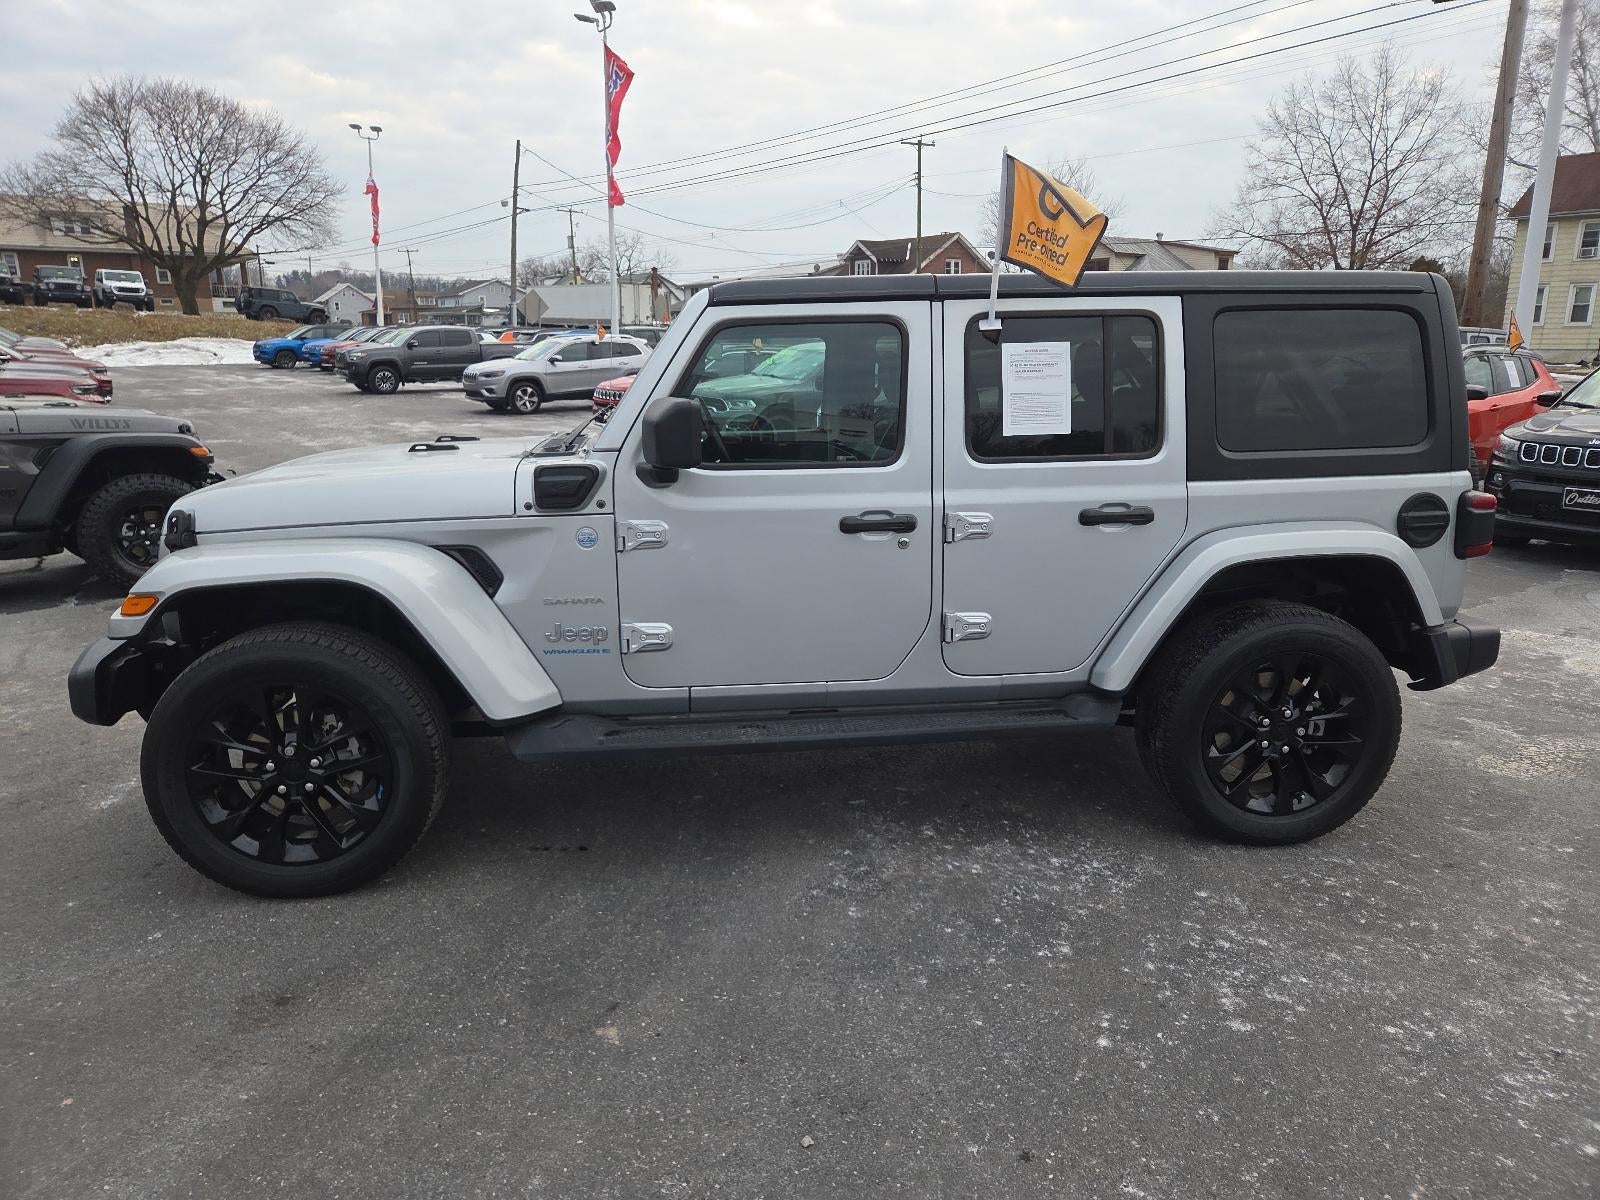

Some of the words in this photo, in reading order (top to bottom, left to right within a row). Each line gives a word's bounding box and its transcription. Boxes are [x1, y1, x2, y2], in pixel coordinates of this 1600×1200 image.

[69, 418, 131, 430] WILLYS
[543, 597, 605, 606] SAHARA
[544, 622, 609, 646] Jeep
[543, 648, 600, 656] WRANGLER
